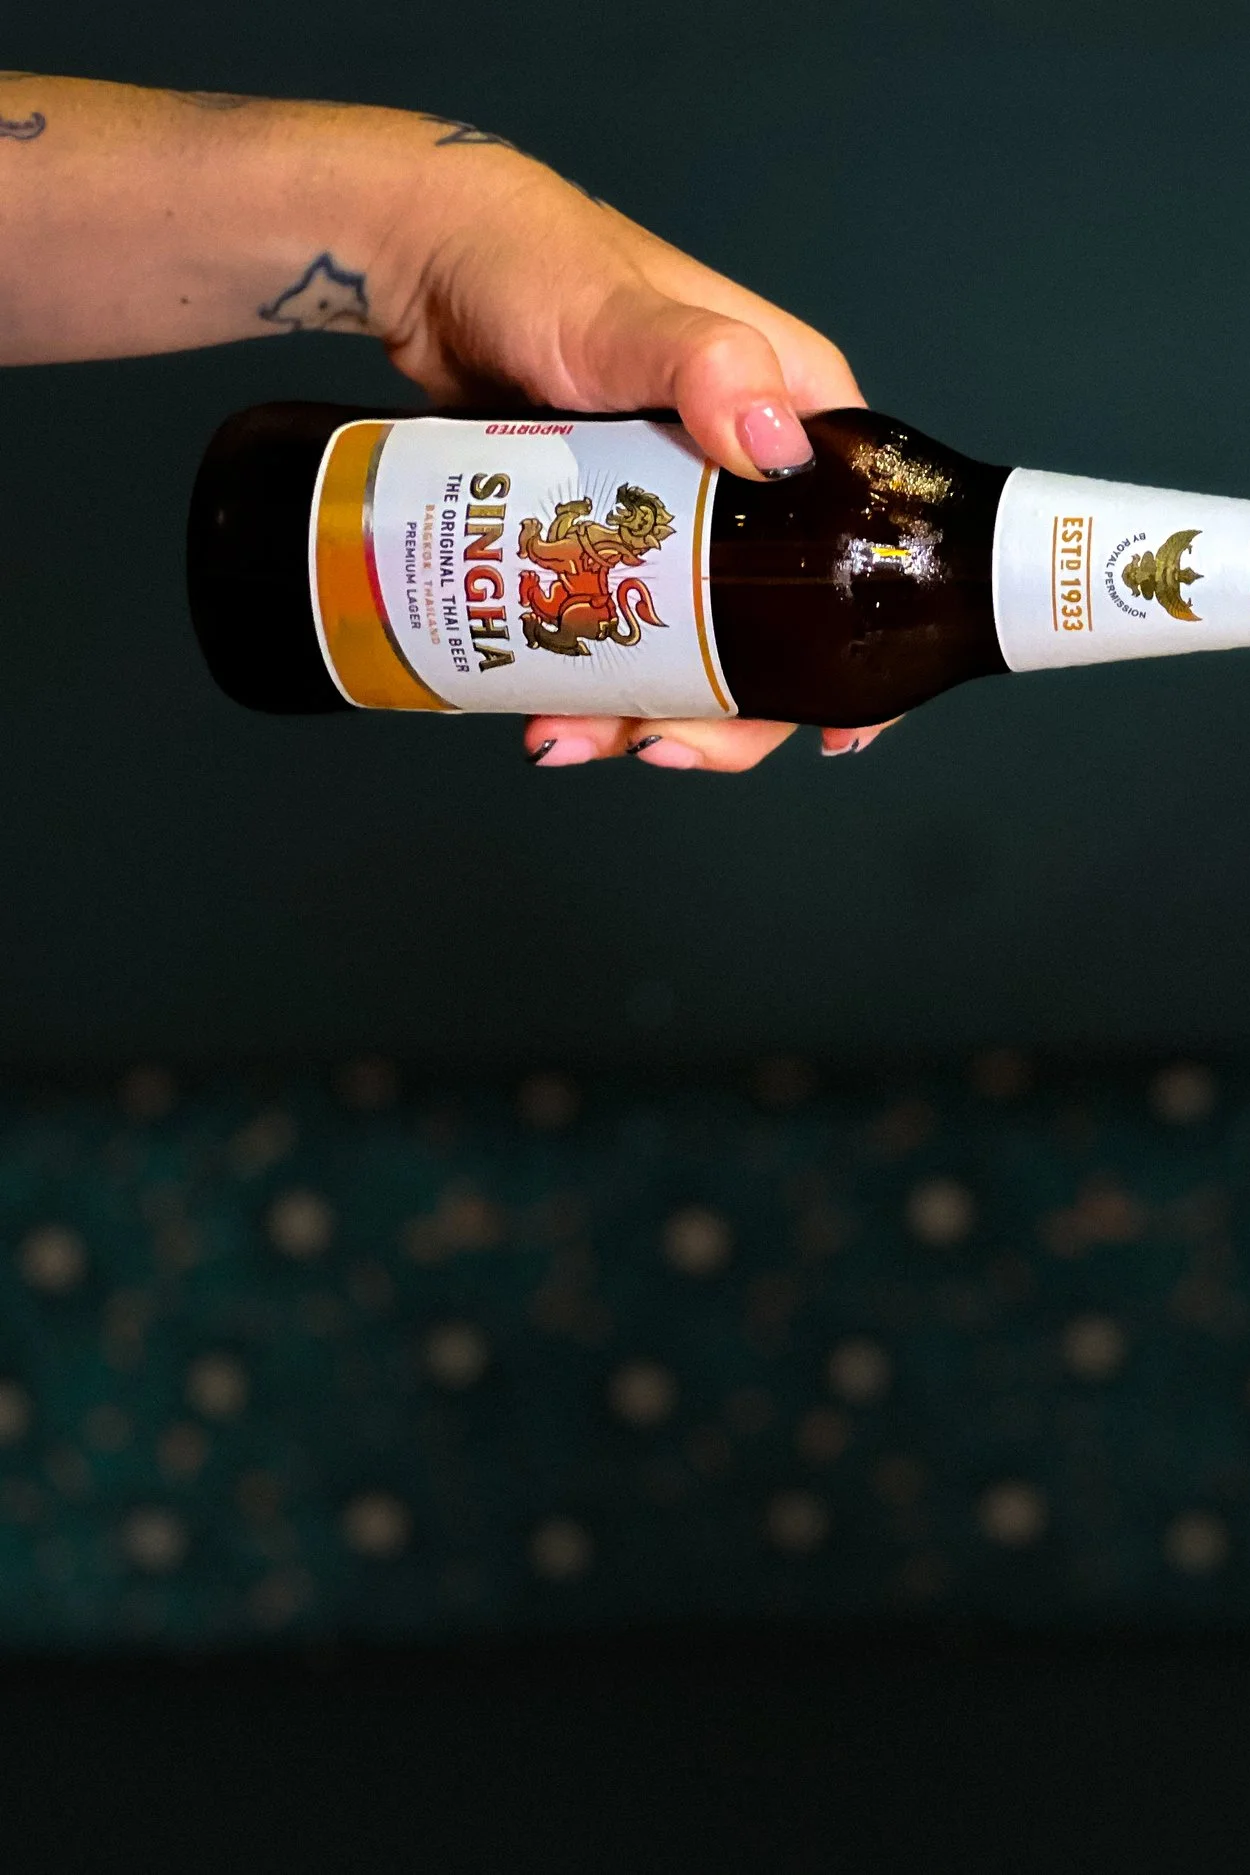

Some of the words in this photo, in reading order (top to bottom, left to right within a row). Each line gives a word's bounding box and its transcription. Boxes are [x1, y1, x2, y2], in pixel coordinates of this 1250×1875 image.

[485, 424, 574, 435] IMPORTED
[445, 473, 463, 502] THE
[405, 522, 418, 585] PREMIUM
[421, 504, 435, 570] BANGKOK
[438, 508, 455, 588] ORIGINAL
[1106, 538, 1131, 568] ROYAL
[1133, 532, 1146, 544] BY
[463, 472, 515, 673] SINGHA
[1104, 571, 1147, 619] PERMISSION
[406, 588, 421, 630] LAGER
[423, 579, 441, 645] THAILAND
[441, 594, 459, 632] THAI
[1061, 578, 1084, 632] 1933
[448, 637, 470, 673] BEER
